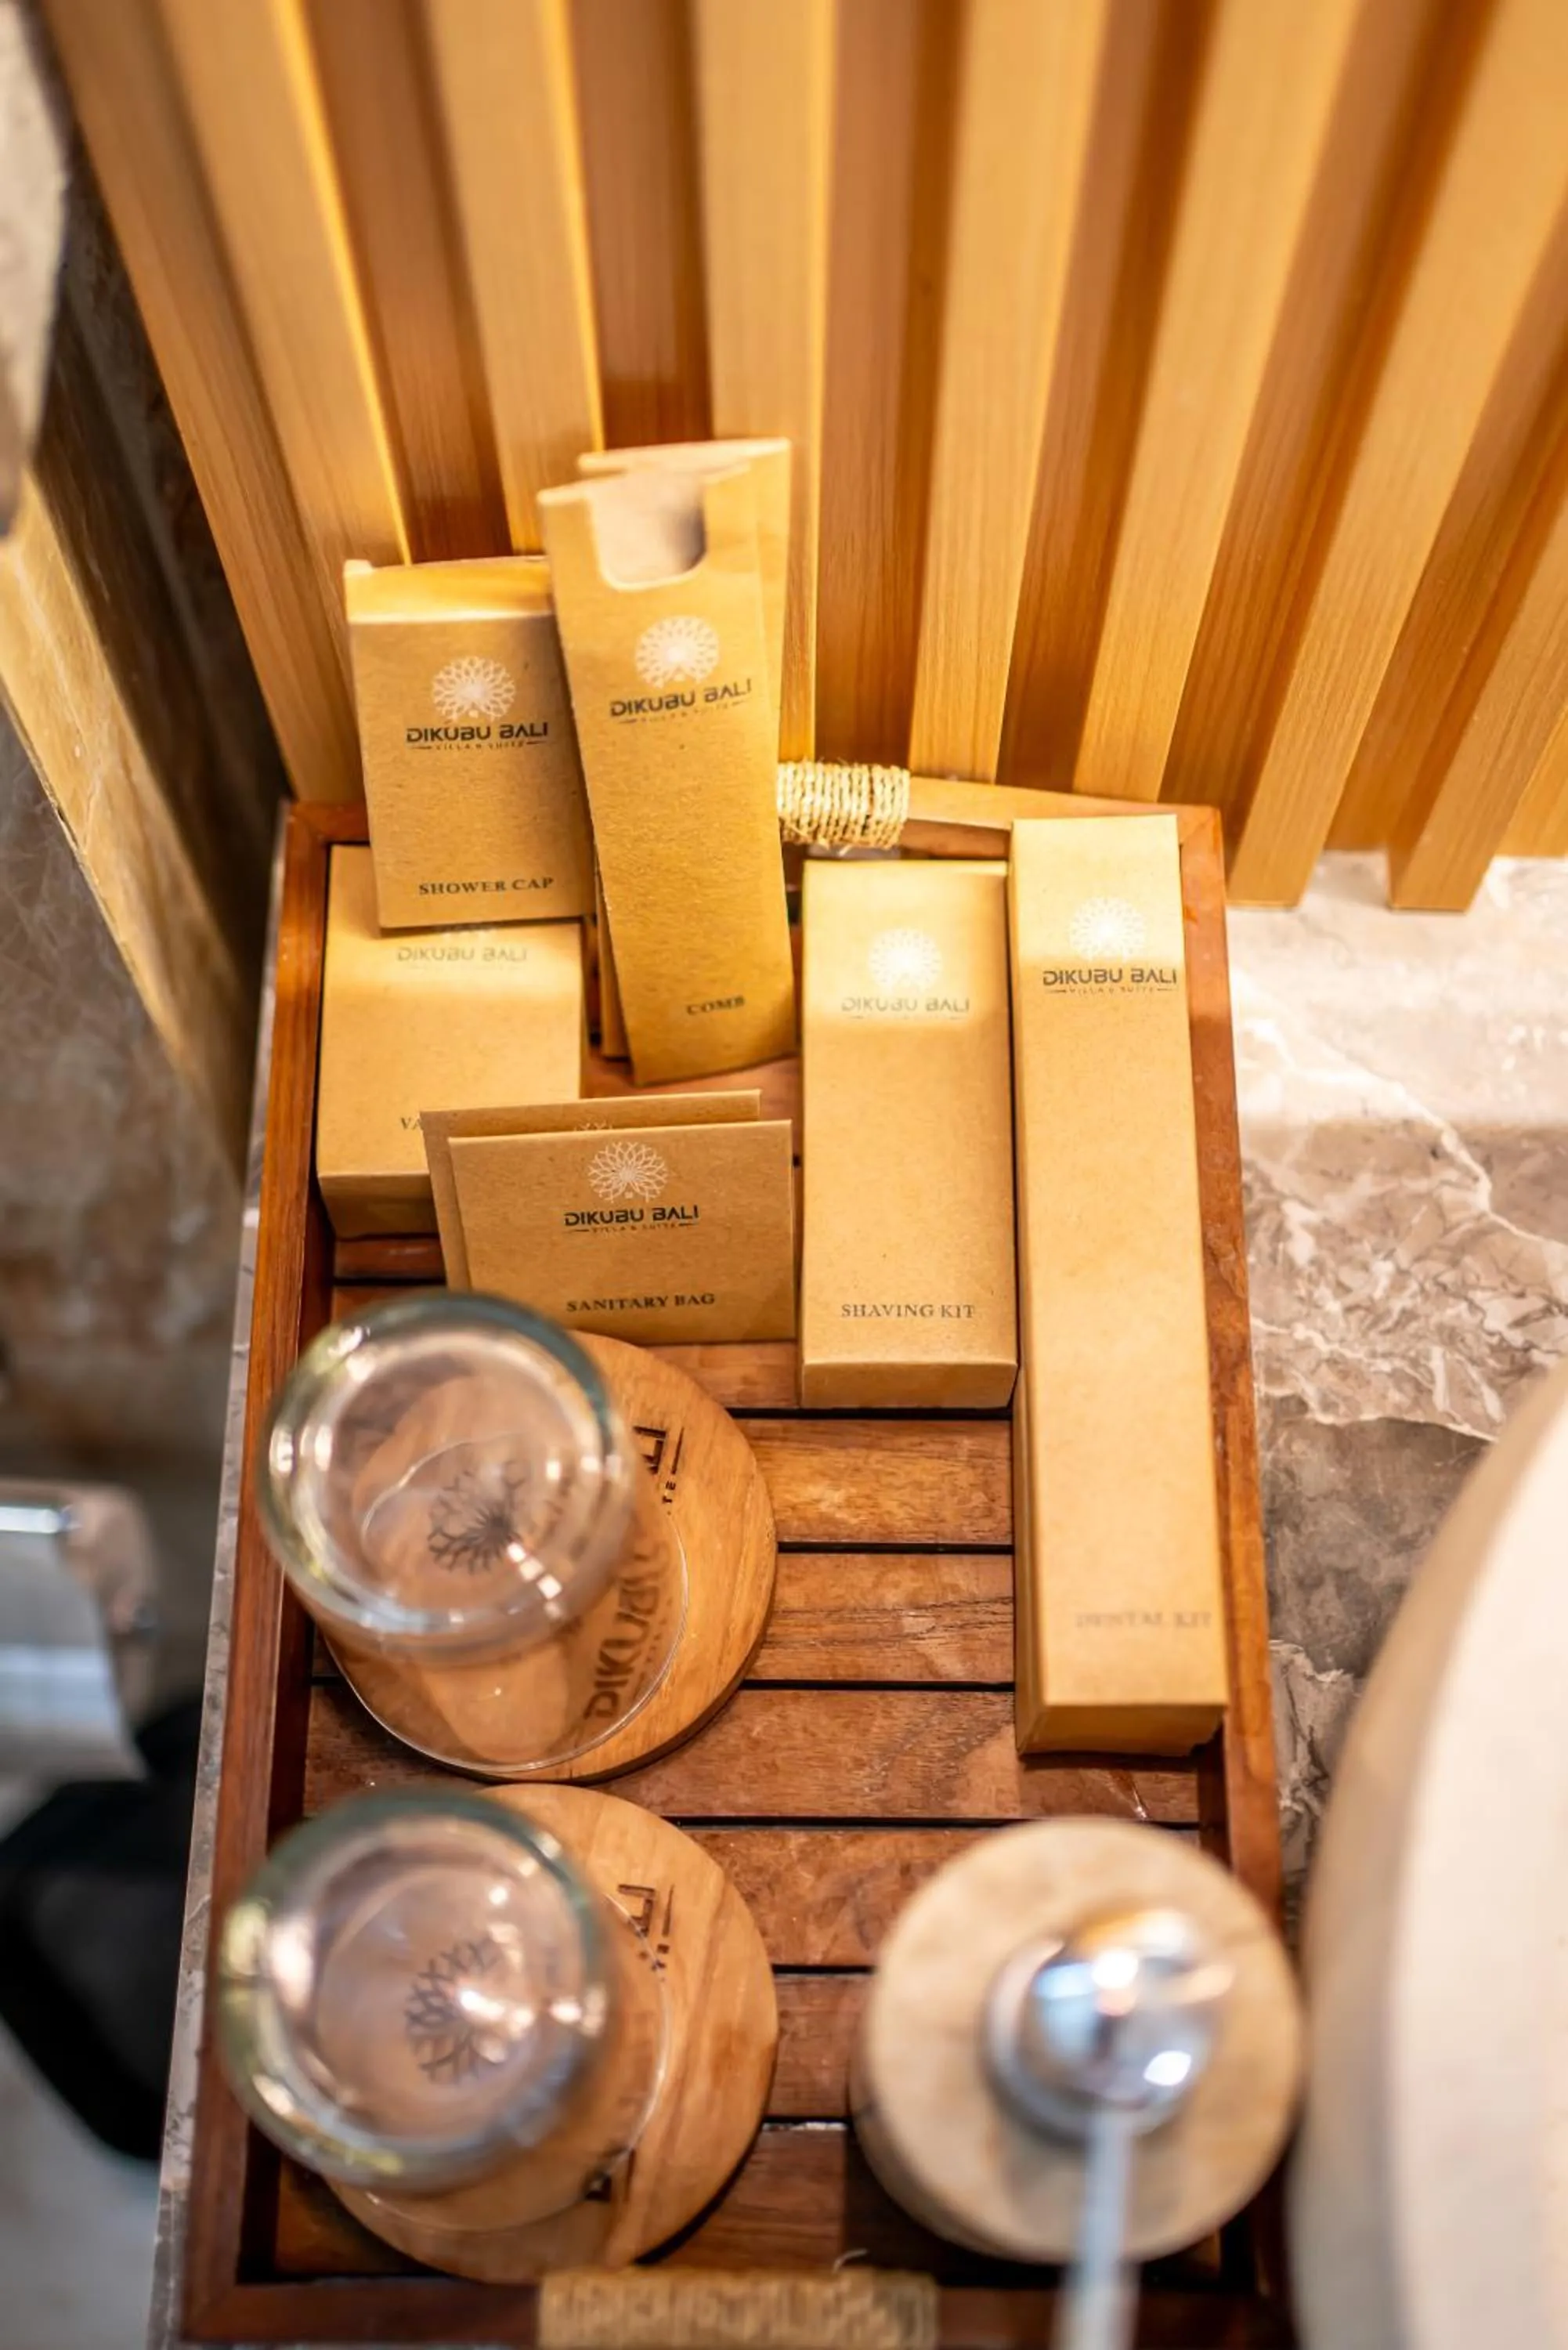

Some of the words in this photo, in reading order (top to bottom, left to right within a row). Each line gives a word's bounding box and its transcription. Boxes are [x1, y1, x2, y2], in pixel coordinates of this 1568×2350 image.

[610, 691, 695, 717] DIKUBU
[704, 678, 752, 703] BALI
[406, 725, 491, 743] DIKUBU
[500, 721, 548, 739] BALI
[418, 880, 506, 895] SHOWER
[511, 877, 555, 891] CAP
[397, 945, 475, 962] DIKUBU
[482, 945, 528, 962] BALI
[1042, 968, 1123, 986] DIKUBU
[1130, 968, 1177, 985] BALI
[686, 995, 745, 1016] COMB
[841, 996, 918, 1012] DIKUBU
[926, 996, 970, 1012] BALI
[565, 1209, 645, 1226] DIKUBU
[652, 1204, 699, 1221] BALI
[566, 1296, 669, 1312] SANITARY
[674, 1292, 715, 1307] BAG
[841, 1303, 934, 1318] SHAVING
[941, 1303, 975, 1318] KIT
[1175, 1611, 1212, 1629] KIT
